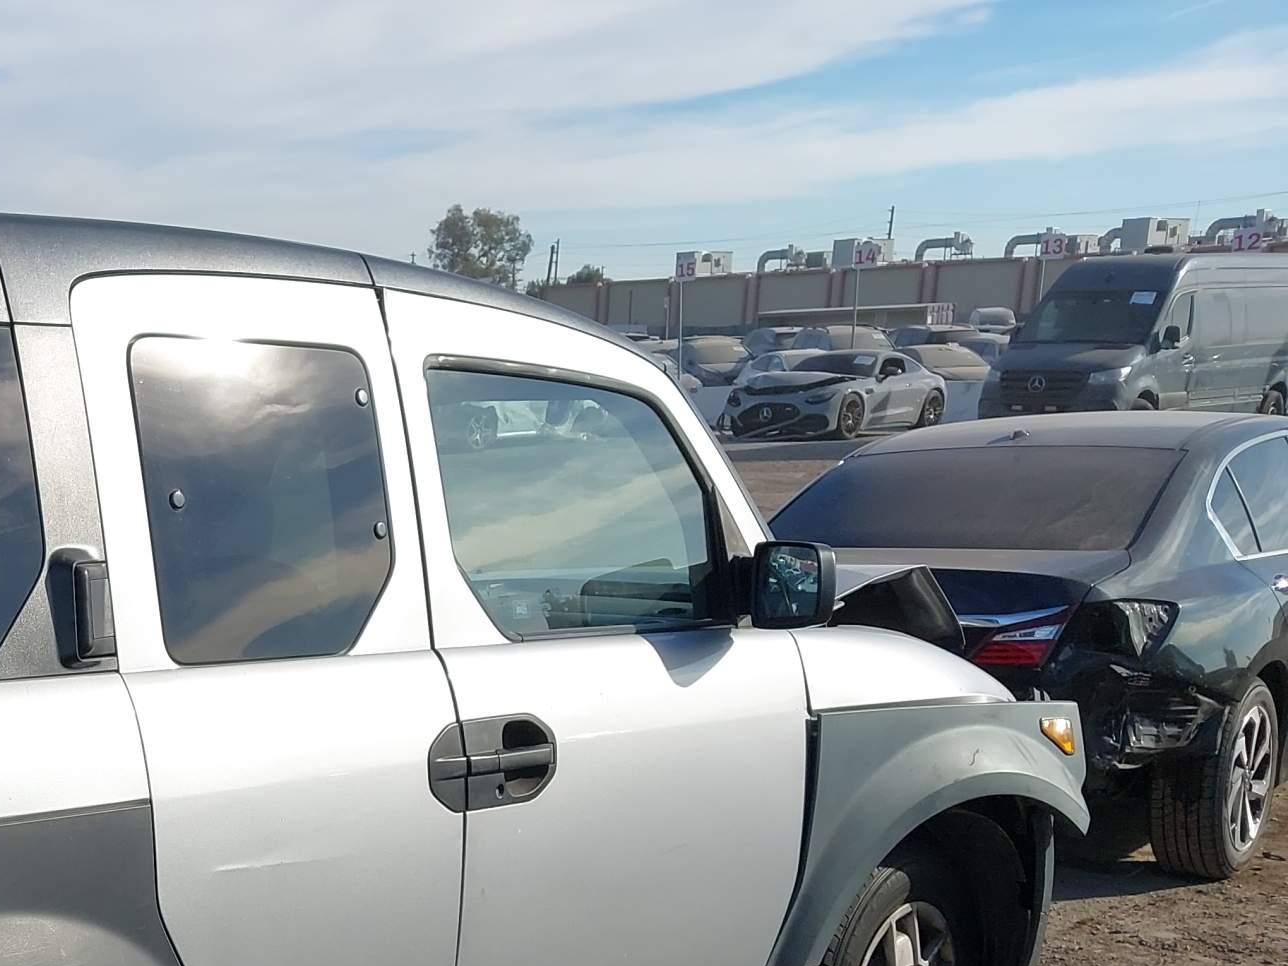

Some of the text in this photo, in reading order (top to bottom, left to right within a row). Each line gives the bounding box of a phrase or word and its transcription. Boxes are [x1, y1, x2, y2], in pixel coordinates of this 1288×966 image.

[1042, 239, 1063, 254] 13
[1234, 232, 1261, 251] 12
[855, 249, 876, 264] 14
[678, 263, 695, 277] 15
